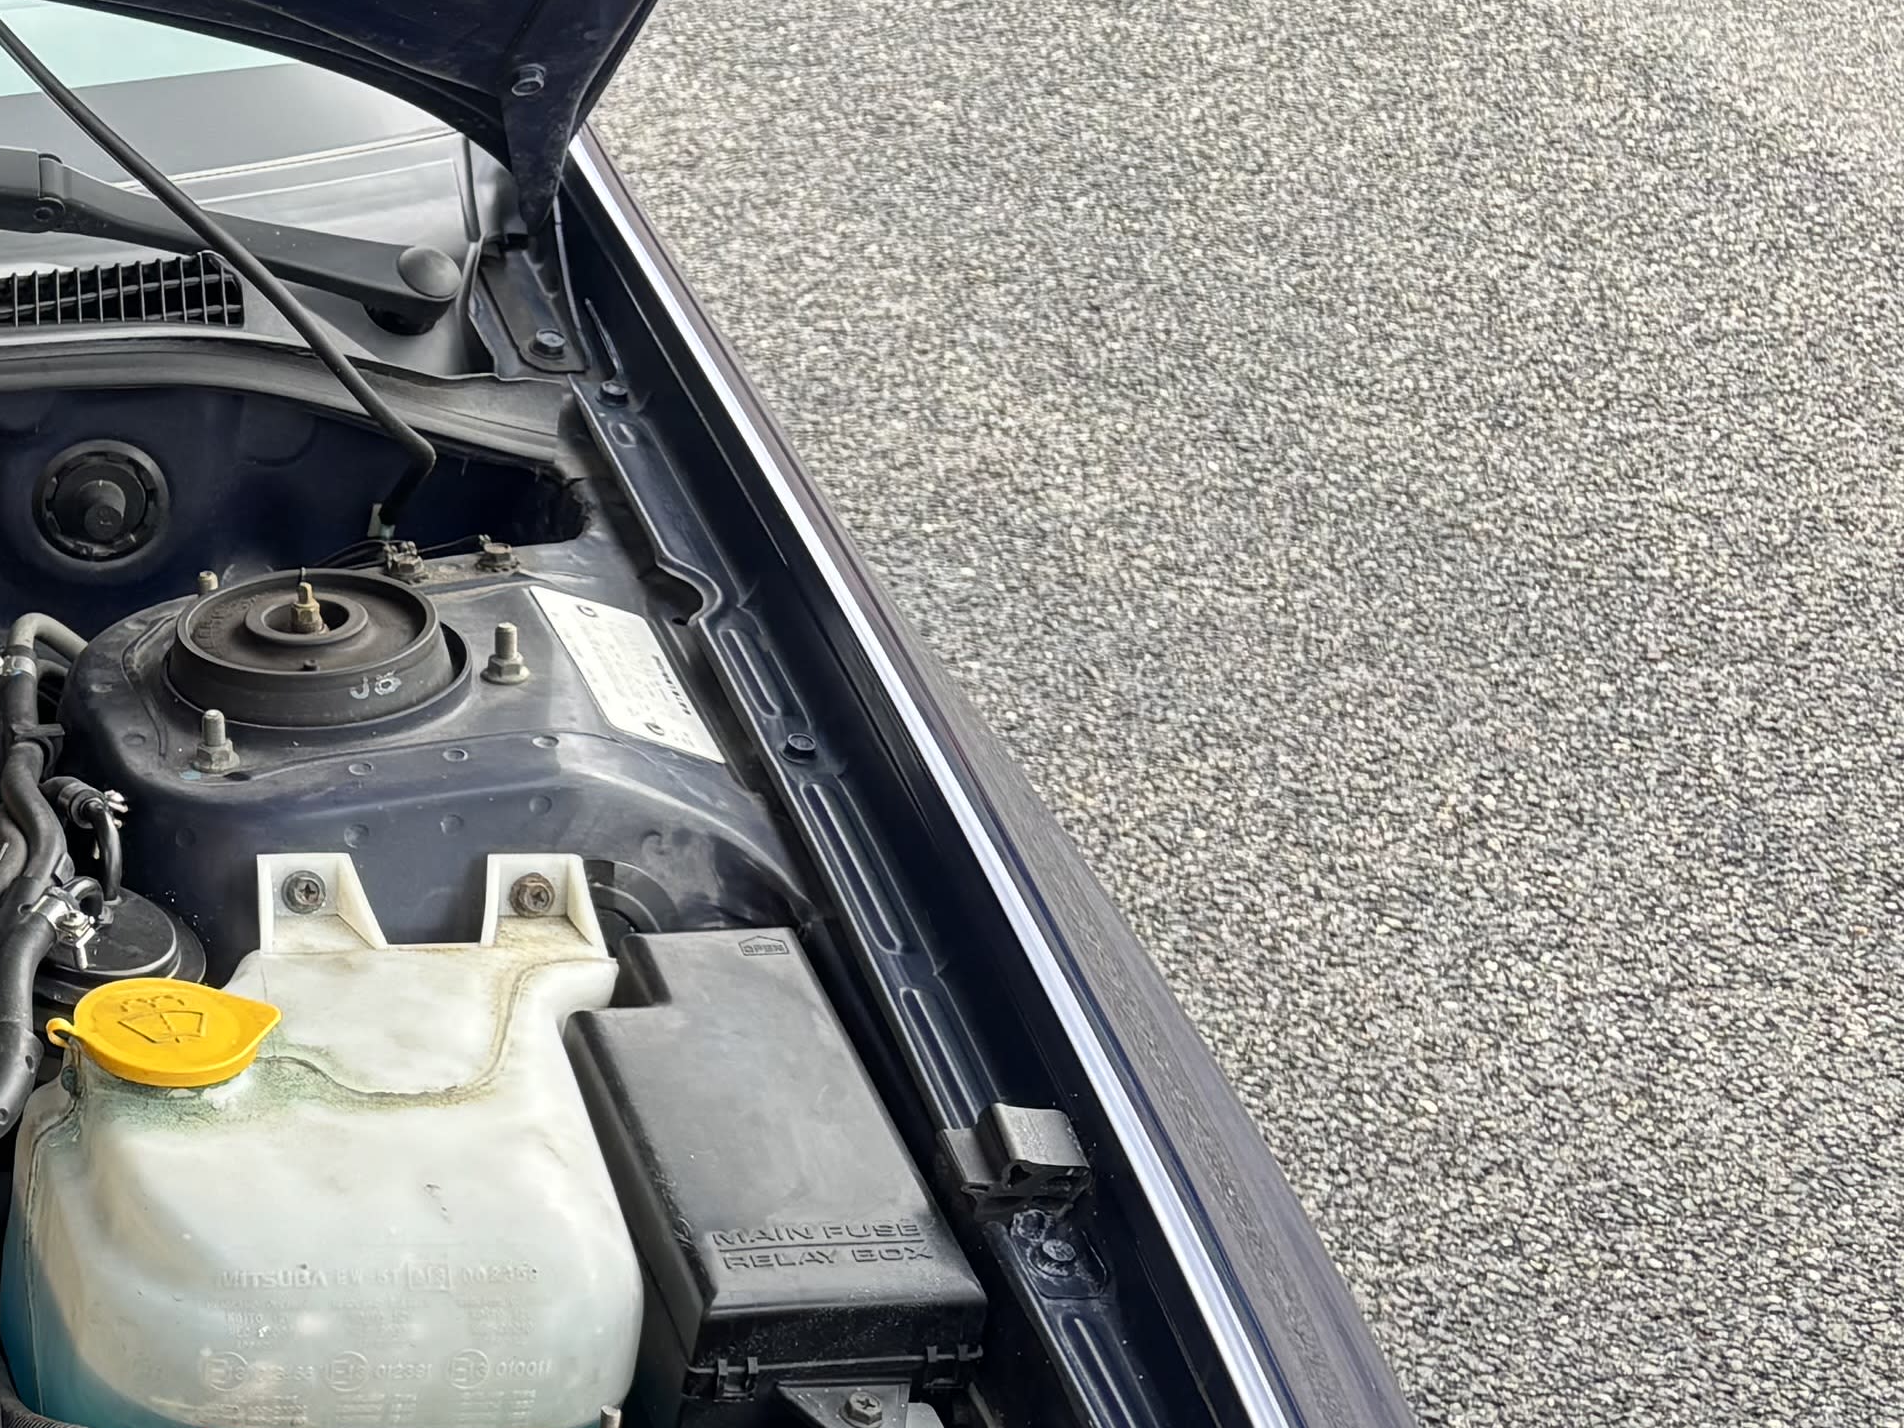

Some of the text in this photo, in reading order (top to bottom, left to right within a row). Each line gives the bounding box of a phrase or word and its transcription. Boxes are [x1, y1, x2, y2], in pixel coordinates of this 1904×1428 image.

[712, 1221, 922, 1247] MAIN FUSE
[723, 1246, 933, 1270] RELAY BOX
